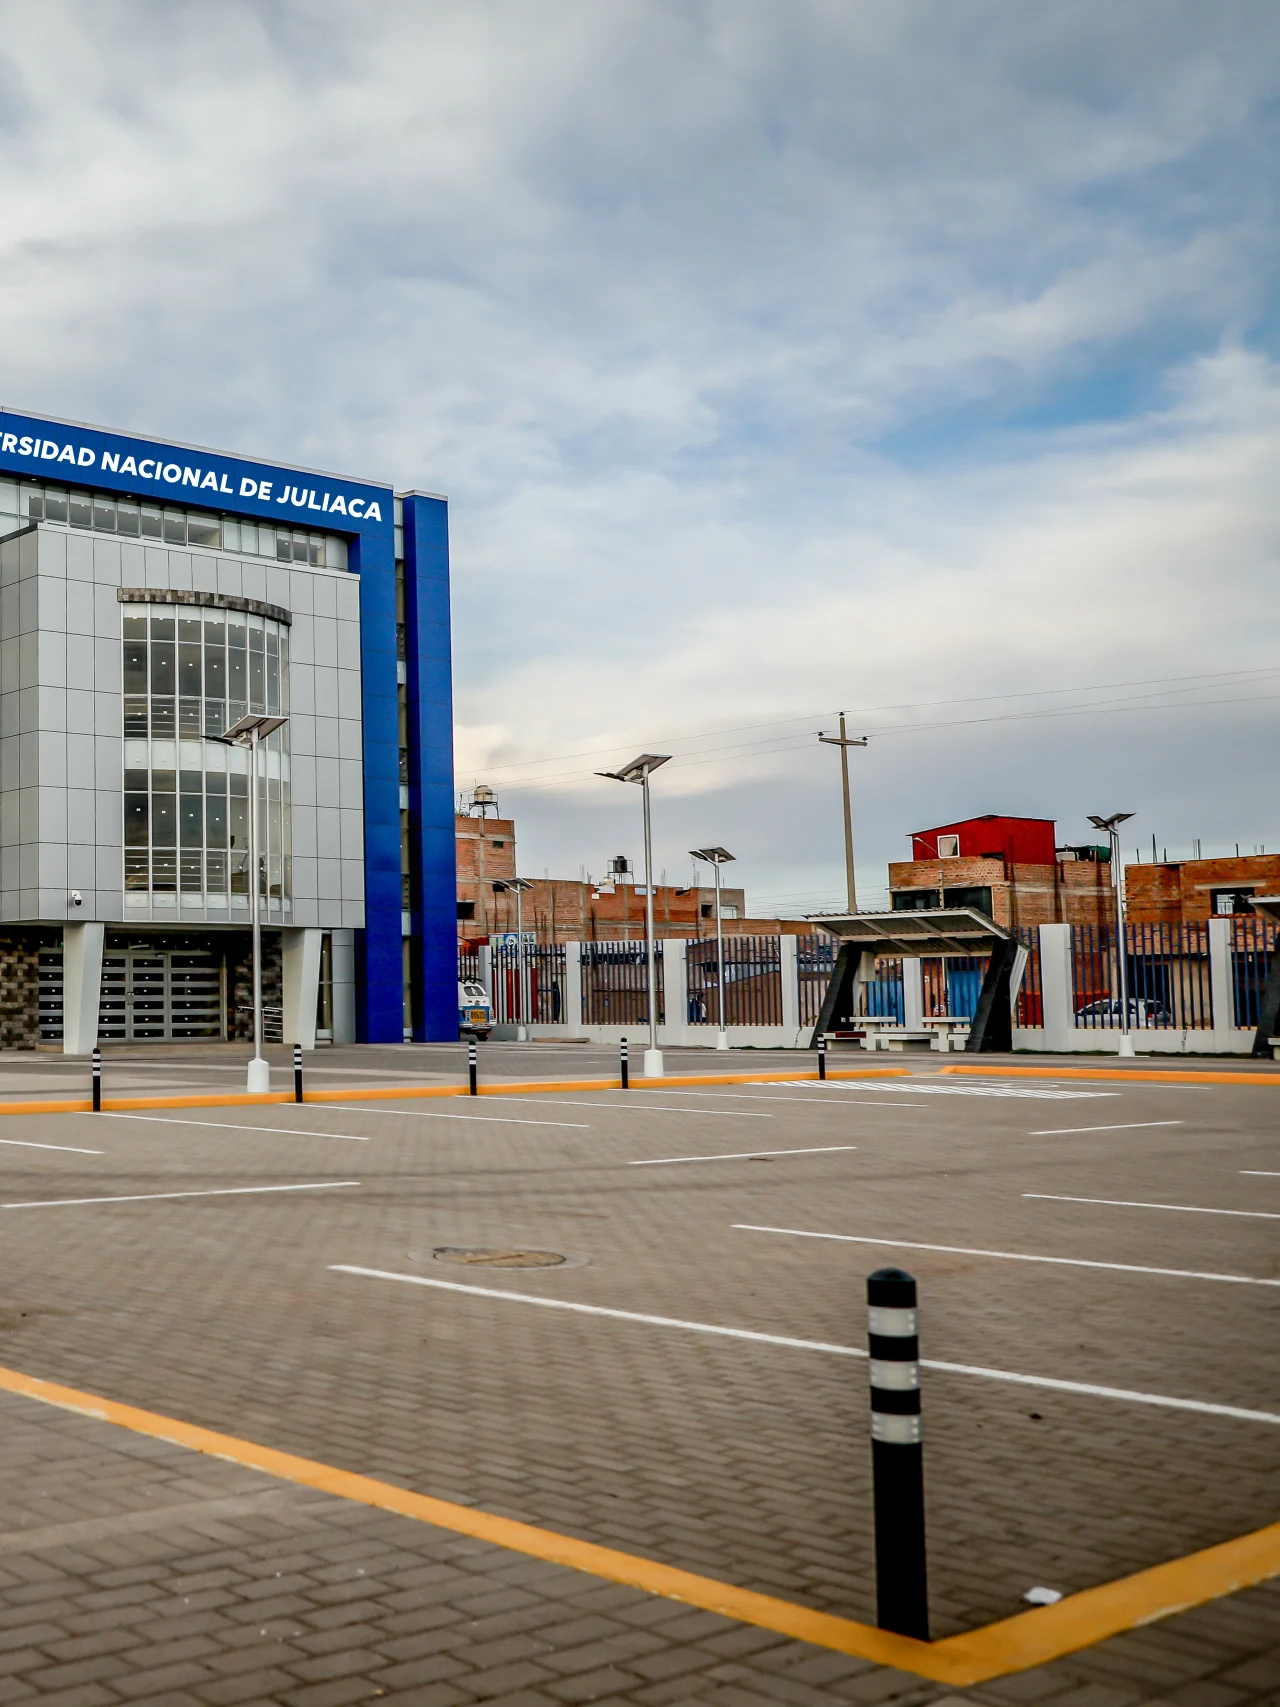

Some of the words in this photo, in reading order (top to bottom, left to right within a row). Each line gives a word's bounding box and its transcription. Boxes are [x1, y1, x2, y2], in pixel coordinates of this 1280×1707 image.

[100, 451, 234, 494] NACIONAL
[239, 477, 273, 501] DE
[276, 485, 382, 522] JULIACA
